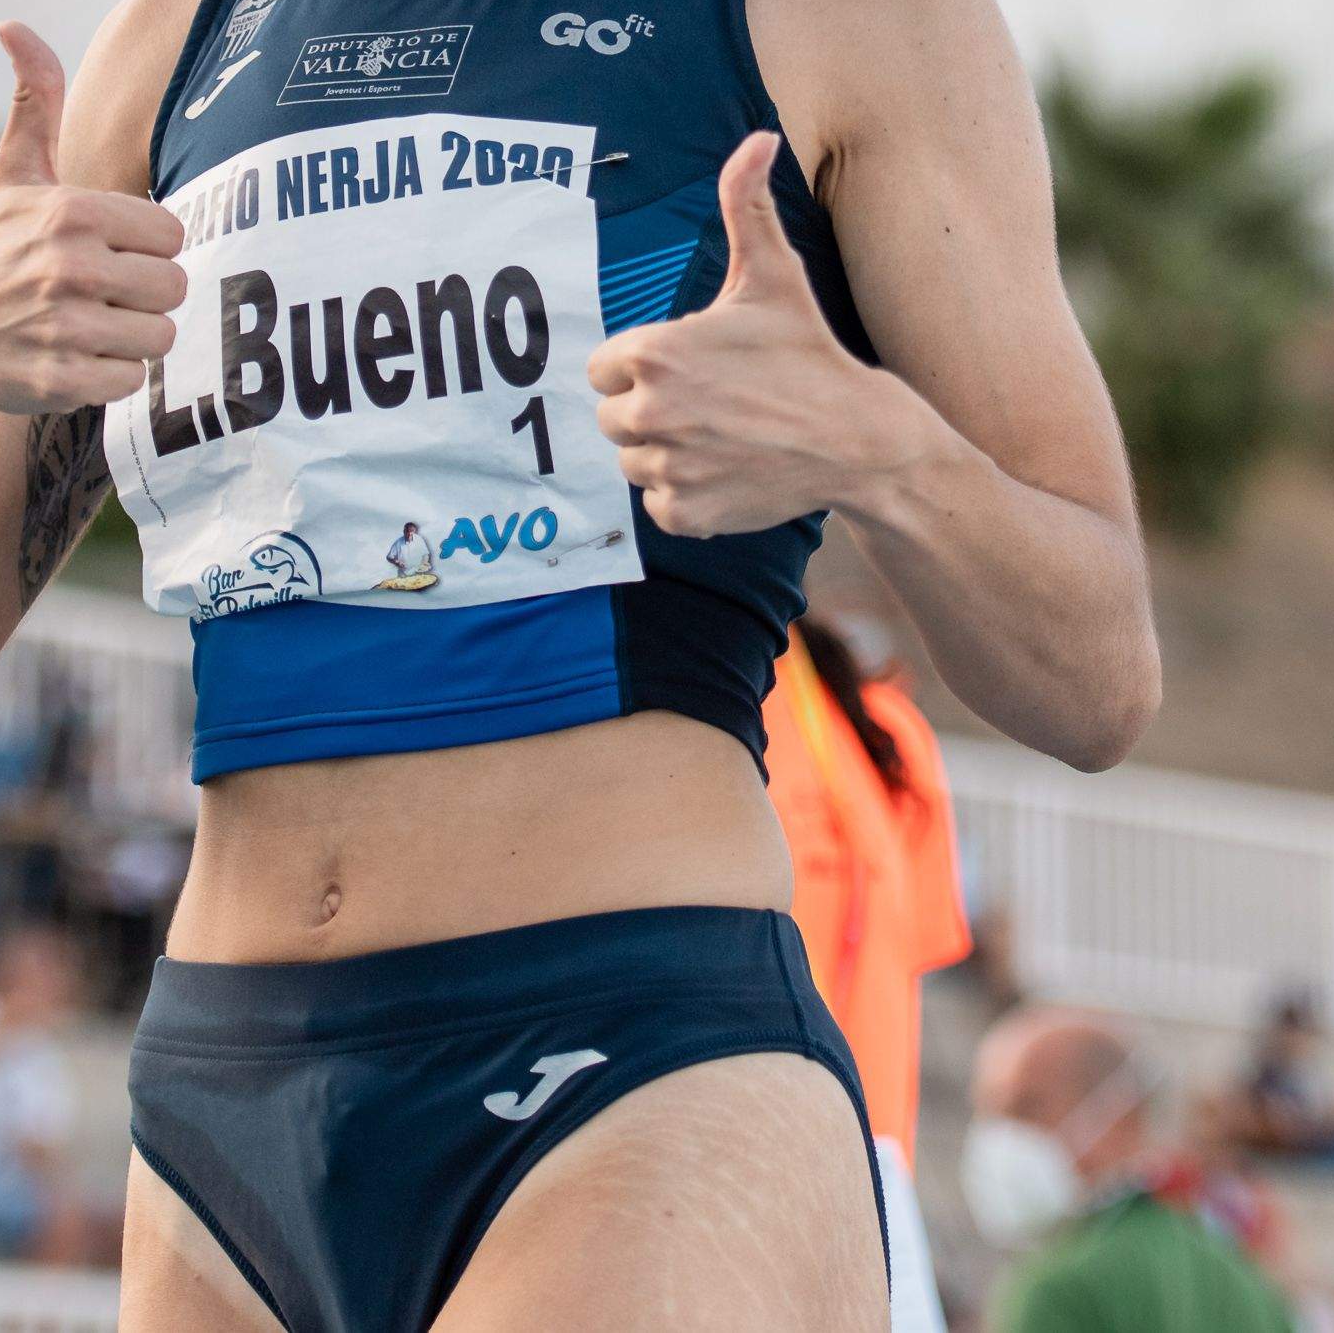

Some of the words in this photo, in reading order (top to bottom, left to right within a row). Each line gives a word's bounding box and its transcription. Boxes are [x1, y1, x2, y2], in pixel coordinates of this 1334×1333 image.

[430, 33, 458, 44] DE
[368, 84, 401, 95] Esports
[276, 135, 424, 222] NERJA
[441, 130, 574, 192] 2020
[148, 265, 550, 458] L.Bueno
[510, 395, 555, 476] 1
[201, 564, 245, 601] Bar
